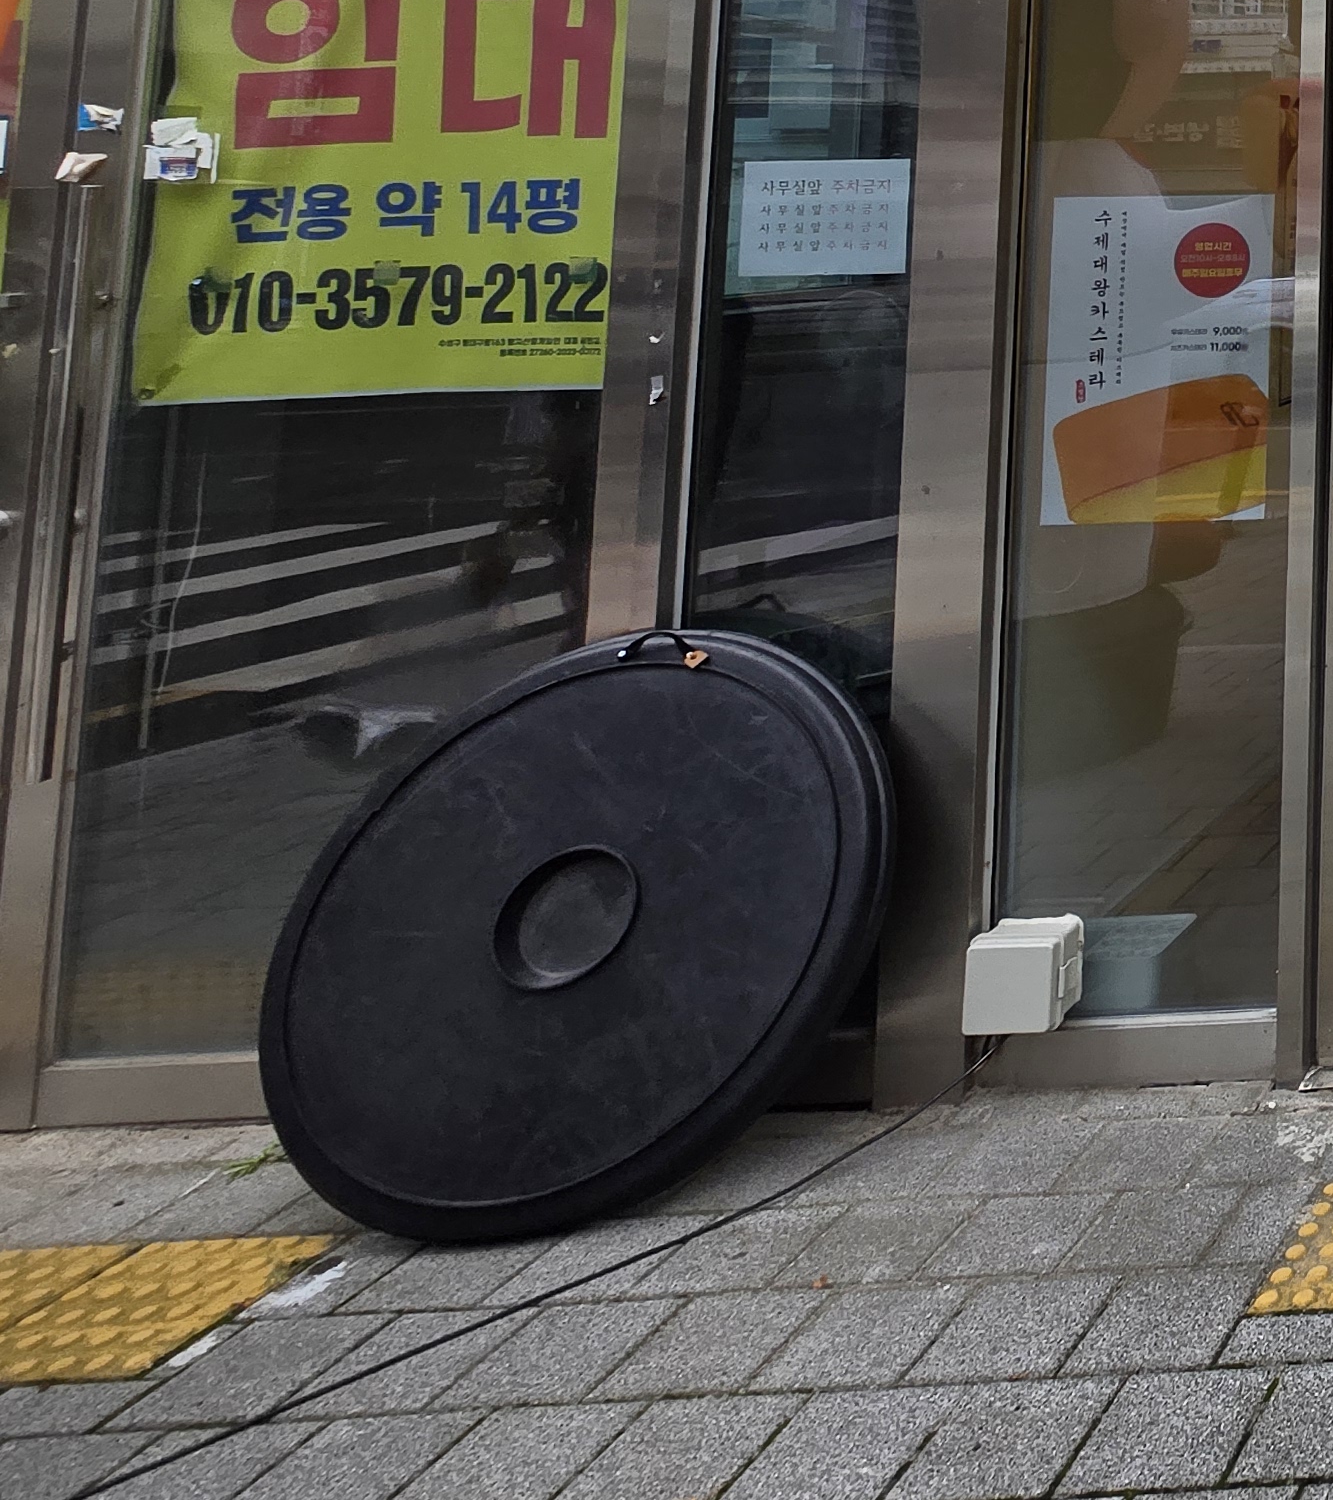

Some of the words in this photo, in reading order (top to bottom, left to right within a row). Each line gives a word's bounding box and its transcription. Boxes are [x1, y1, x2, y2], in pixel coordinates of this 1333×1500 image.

[231, 184, 351, 243] 전용
[375, 181, 442, 238] 약
[461, 177, 581, 238] 14평
[761, 180, 822, 195] 사무실앞
[832, 179, 891, 194] 주차금지
[189, 258, 609, 335] 010-3579-2122
[1088, 210, 1112, 390] 수제대왕카스테라
